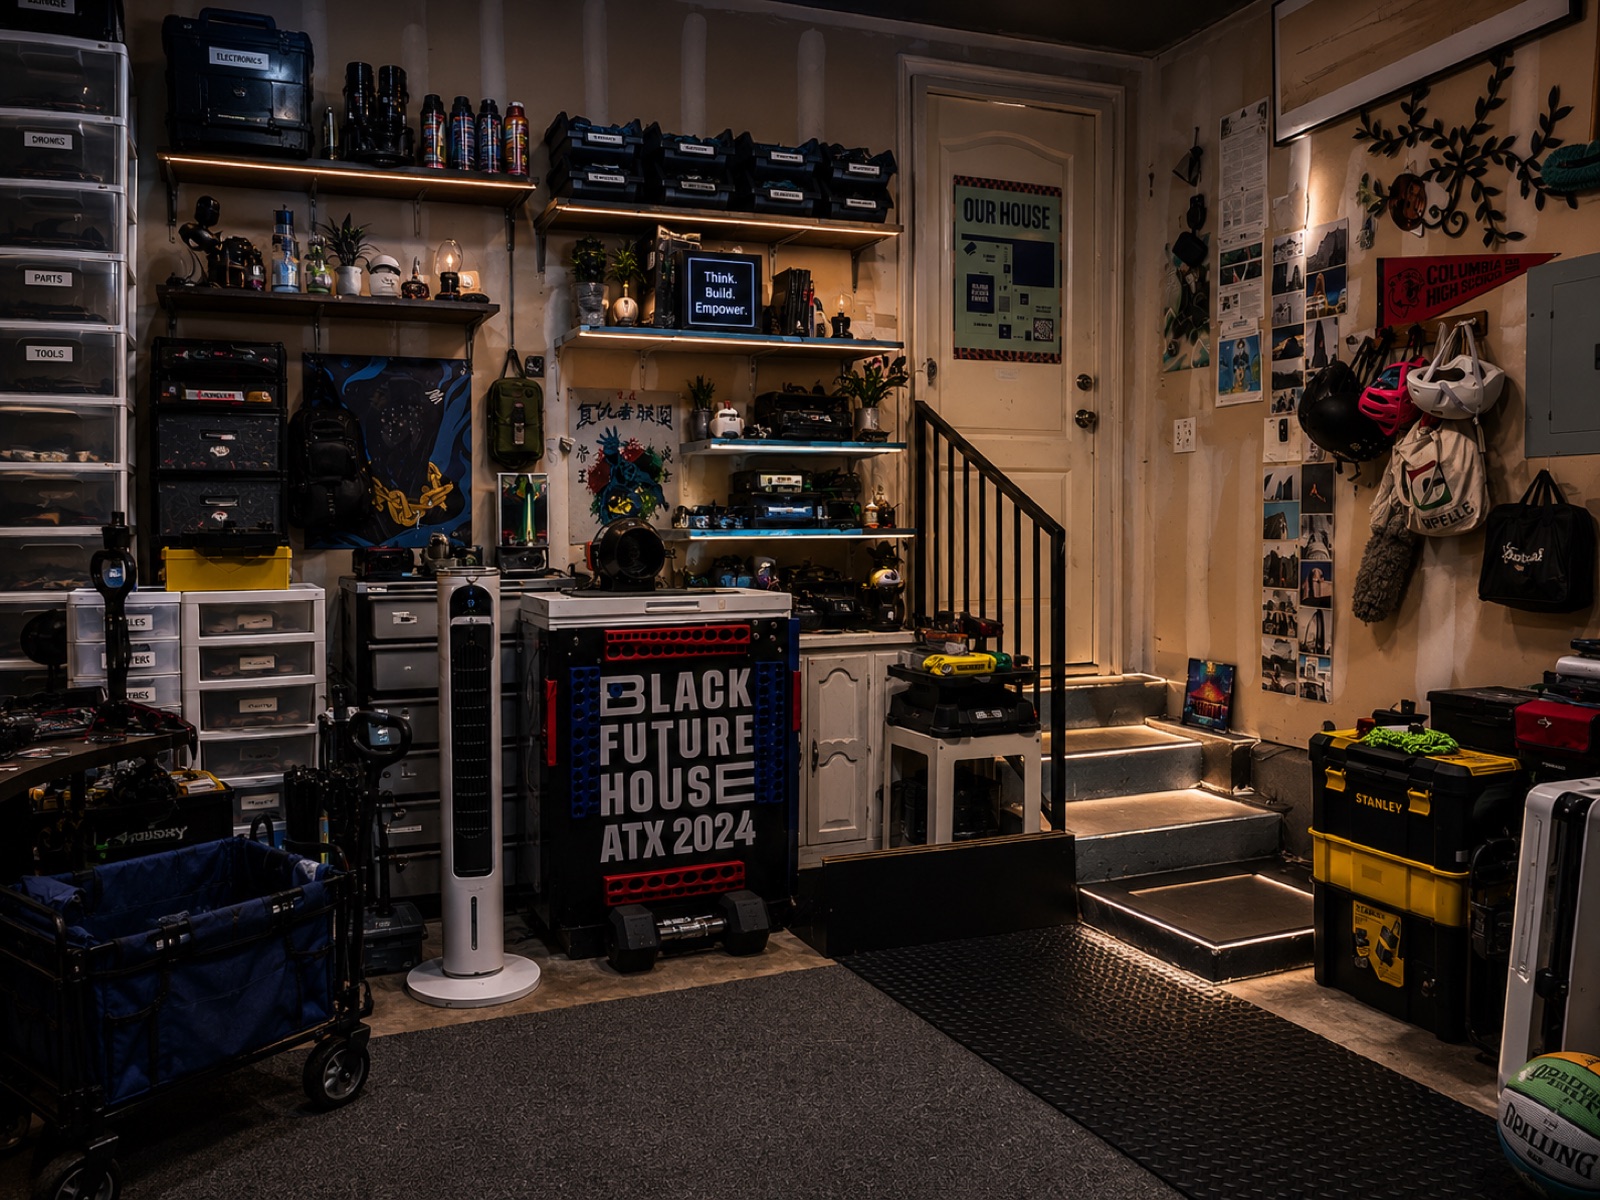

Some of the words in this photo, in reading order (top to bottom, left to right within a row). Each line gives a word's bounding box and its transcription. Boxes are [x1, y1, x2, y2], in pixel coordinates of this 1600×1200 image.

[963, 197, 996, 225] OUR
[999, 201, 1051, 230] HOUSE
[34, 273, 63, 284] PARTS
[703, 270, 738, 285] Think.
[1426, 259, 1502, 286] COLUMBIA
[705, 286, 736, 300] Build.
[1426, 281, 1459, 308] HIGH
[695, 301, 748, 317] Empower.
[35, 349, 64, 359] TOOLS
[599, 667, 753, 718] BLACK
[599, 714, 755, 767] FUTURE
[599, 760, 756, 817] HOUSE
[1355, 792, 1403, 814] STANLEY
[599, 819, 666, 864] ATX
[672, 809, 757, 856] 2024
